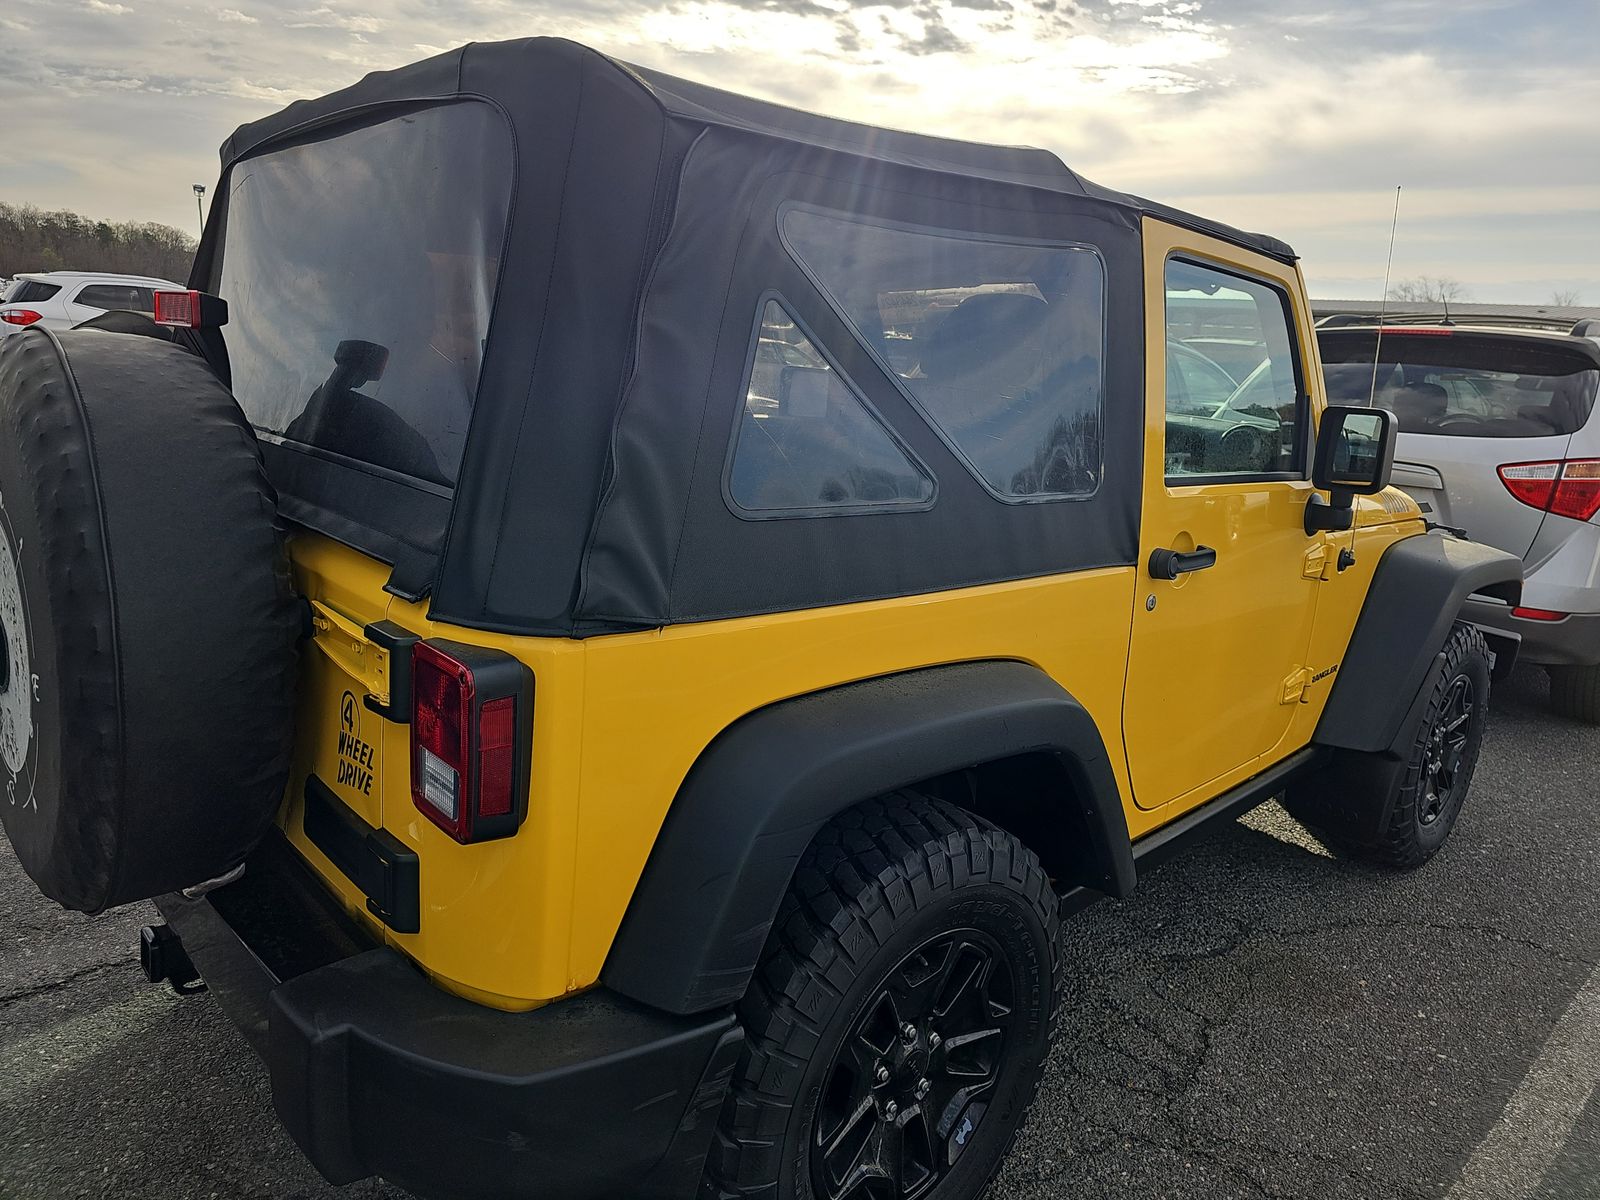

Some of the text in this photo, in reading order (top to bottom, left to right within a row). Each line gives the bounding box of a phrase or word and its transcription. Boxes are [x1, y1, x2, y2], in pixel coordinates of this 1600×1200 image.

[1311, 664, 1338, 683] RANGLER
[343, 698, 354, 733] 4
[337, 730, 374, 772] WHEEL
[337, 758, 374, 797] DRIVE
